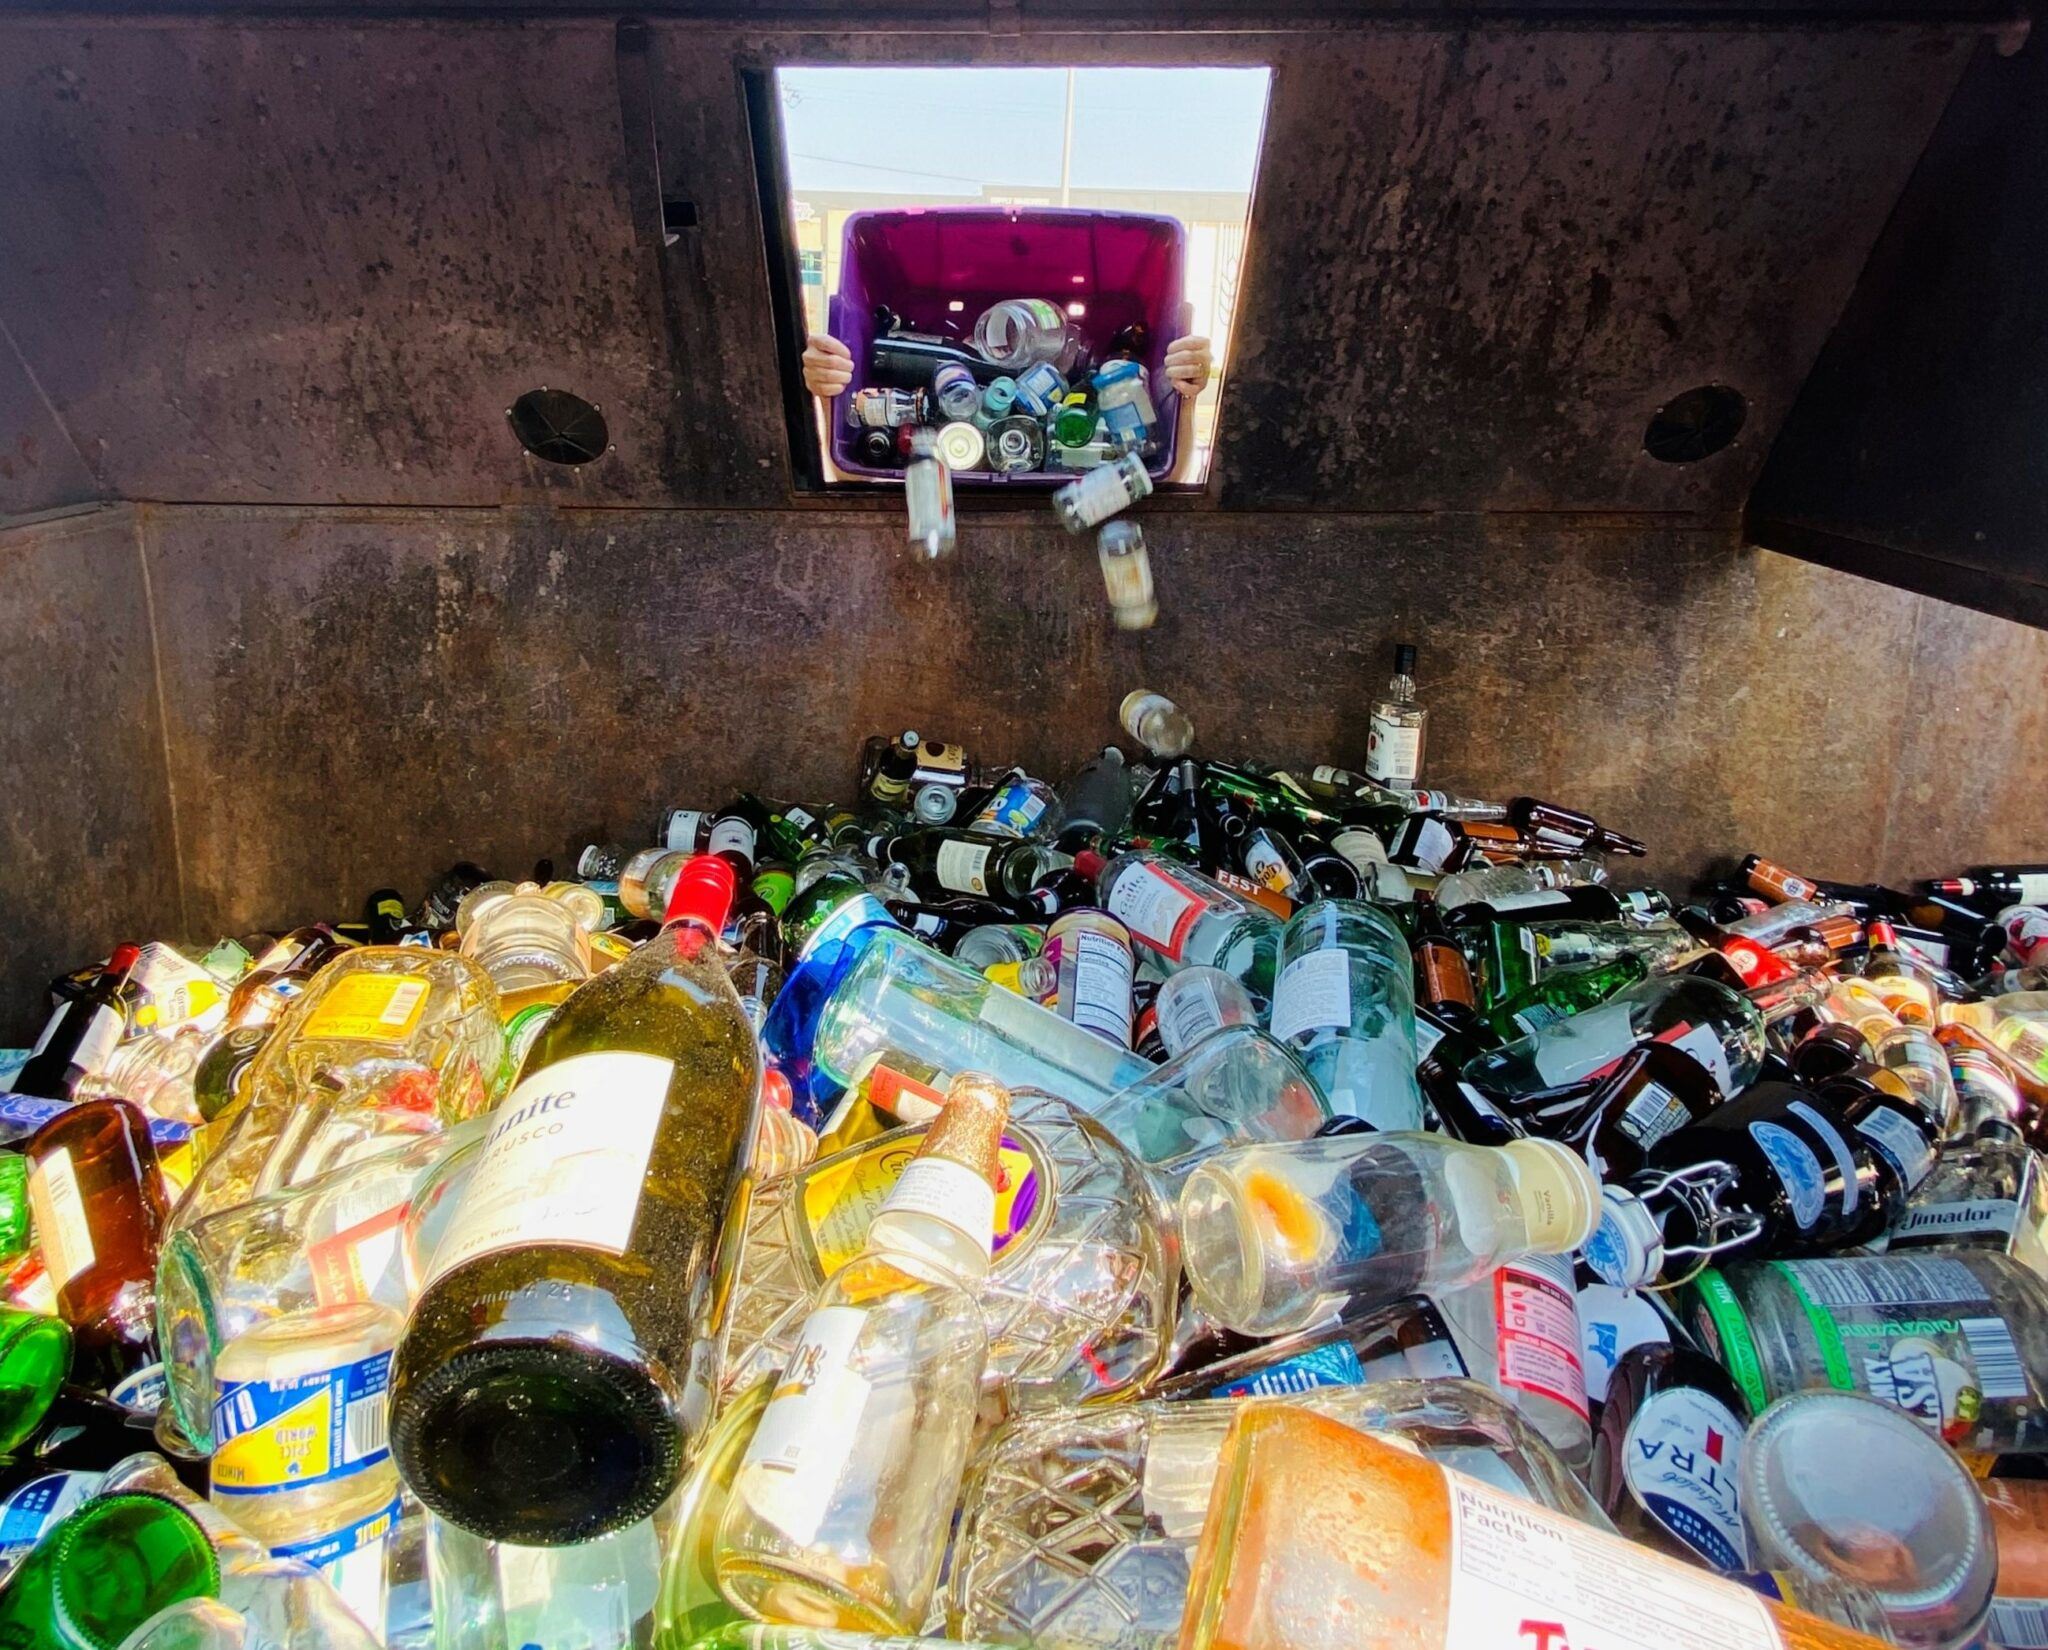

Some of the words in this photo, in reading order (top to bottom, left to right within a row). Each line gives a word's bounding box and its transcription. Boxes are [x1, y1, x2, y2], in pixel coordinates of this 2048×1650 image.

[1217, 869, 1262, 896] FEST
[489, 1091, 575, 1147] unite
[1543, 1190, 1555, 1226] Vanilla
[1900, 1207, 1997, 1230] Jimador
[1712, 1281, 1734, 1304] MILD
[280, 1441, 312, 1459] SPICE
[1638, 1438, 1738, 1513] LTRA
[1460, 1490, 1564, 1542] Nutrition
[1661, 1471, 1740, 1528] Michelob
[1462, 1505, 1528, 1543] Facts
